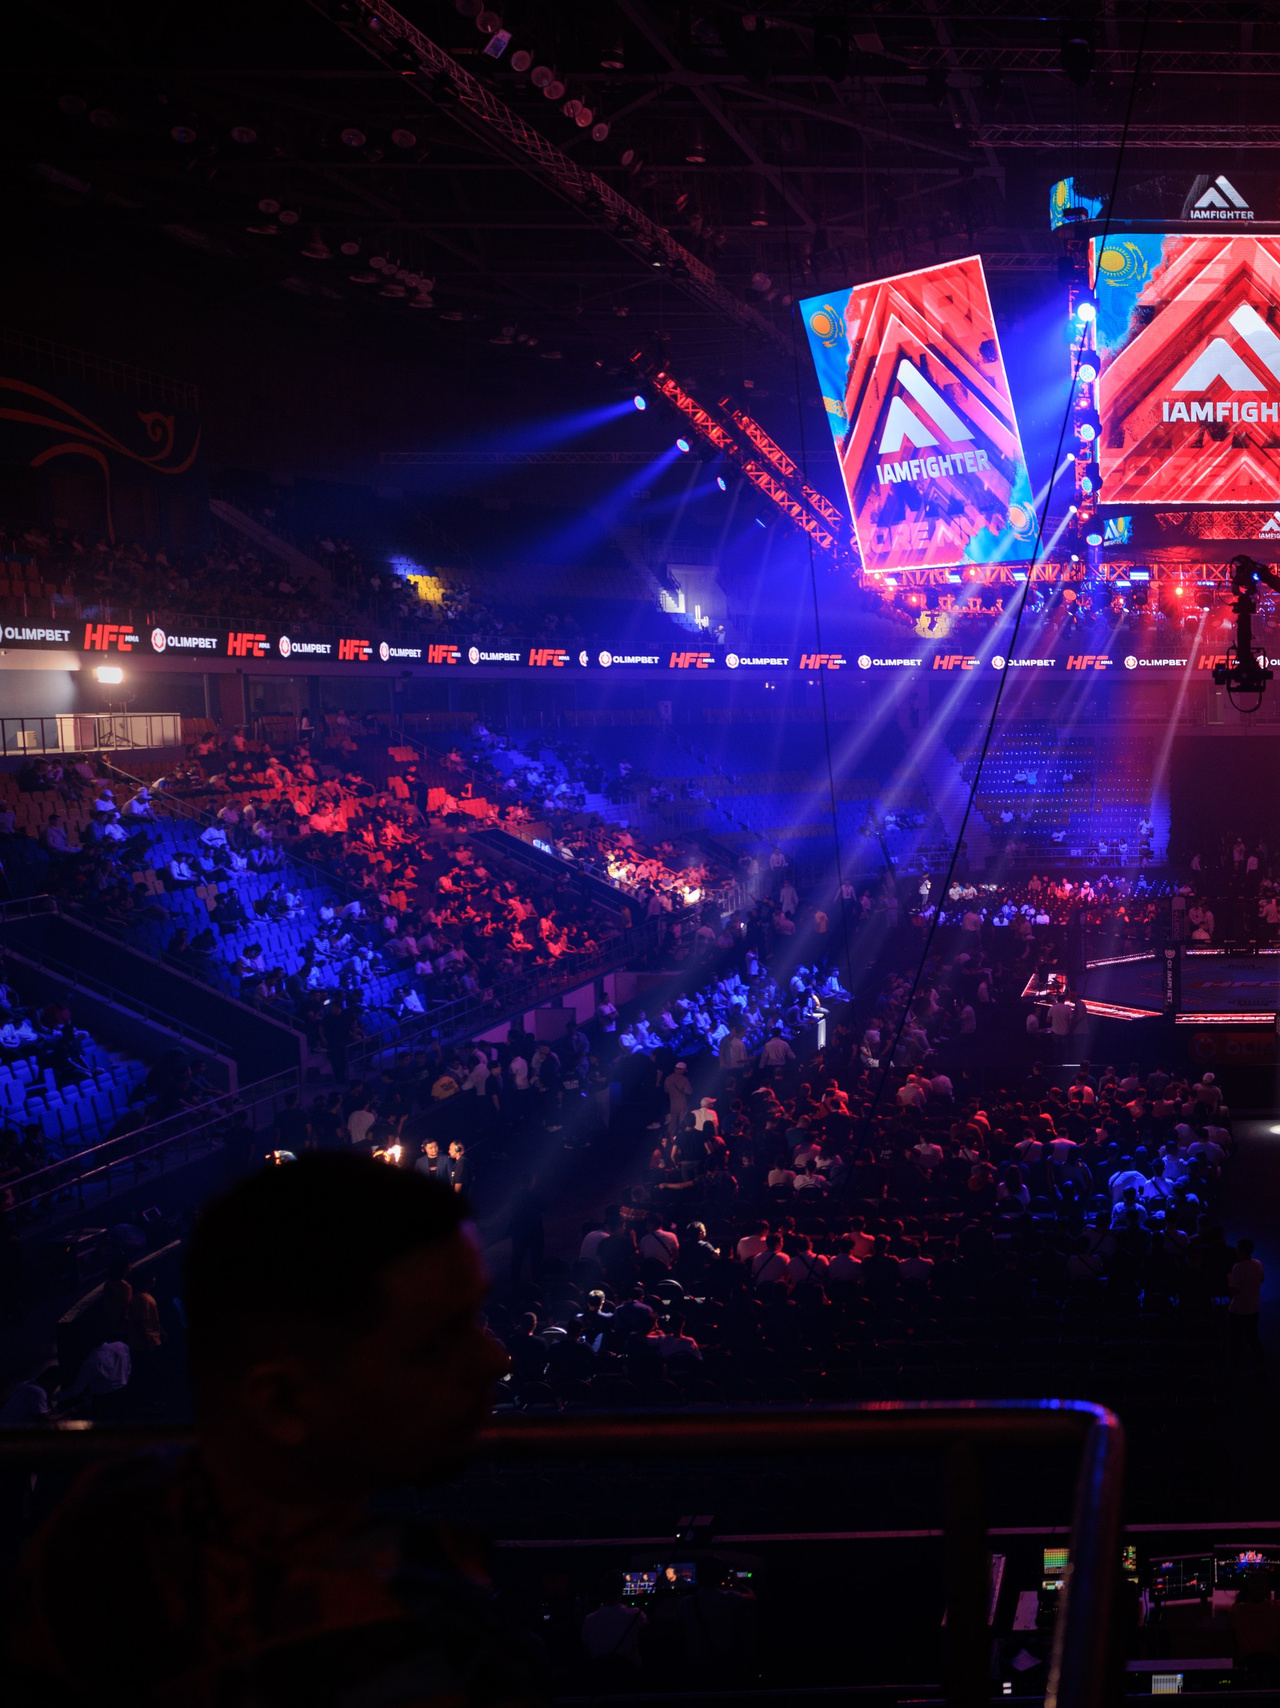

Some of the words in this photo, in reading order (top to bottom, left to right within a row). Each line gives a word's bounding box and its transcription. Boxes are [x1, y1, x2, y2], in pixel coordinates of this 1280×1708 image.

[1190, 209, 1255, 220] IAMFIGHTER
[876, 449, 991, 485] IAMFIGHTER
[5, 626, 70, 642] OLIMPBET
[84, 624, 133, 651] HFC
[124, 634, 140, 643] MMA
[167, 635, 217, 649] OLIMPBET
[228, 633, 266, 656] HFC
[291, 640, 331, 656] OLIMPBET
[339, 639, 369, 660] HFC
[389, 644, 421, 660] OLIMPBET
[428, 645, 457, 663] HFC
[480, 651, 520, 662] OLIMPBET
[529, 649, 565, 666] HFC
[613, 655, 659, 664] OLIMPBET
[670, 653, 710, 668] HFC
[740, 657, 789, 666] OLIMPBET
[800, 655, 842, 669] HFC
[873, 658, 922, 667] OLIMPBET
[933, 655, 975, 669] HFC
[1008, 659, 1055, 667] OLIMPBET
[1067, 656, 1108, 669] HFC
